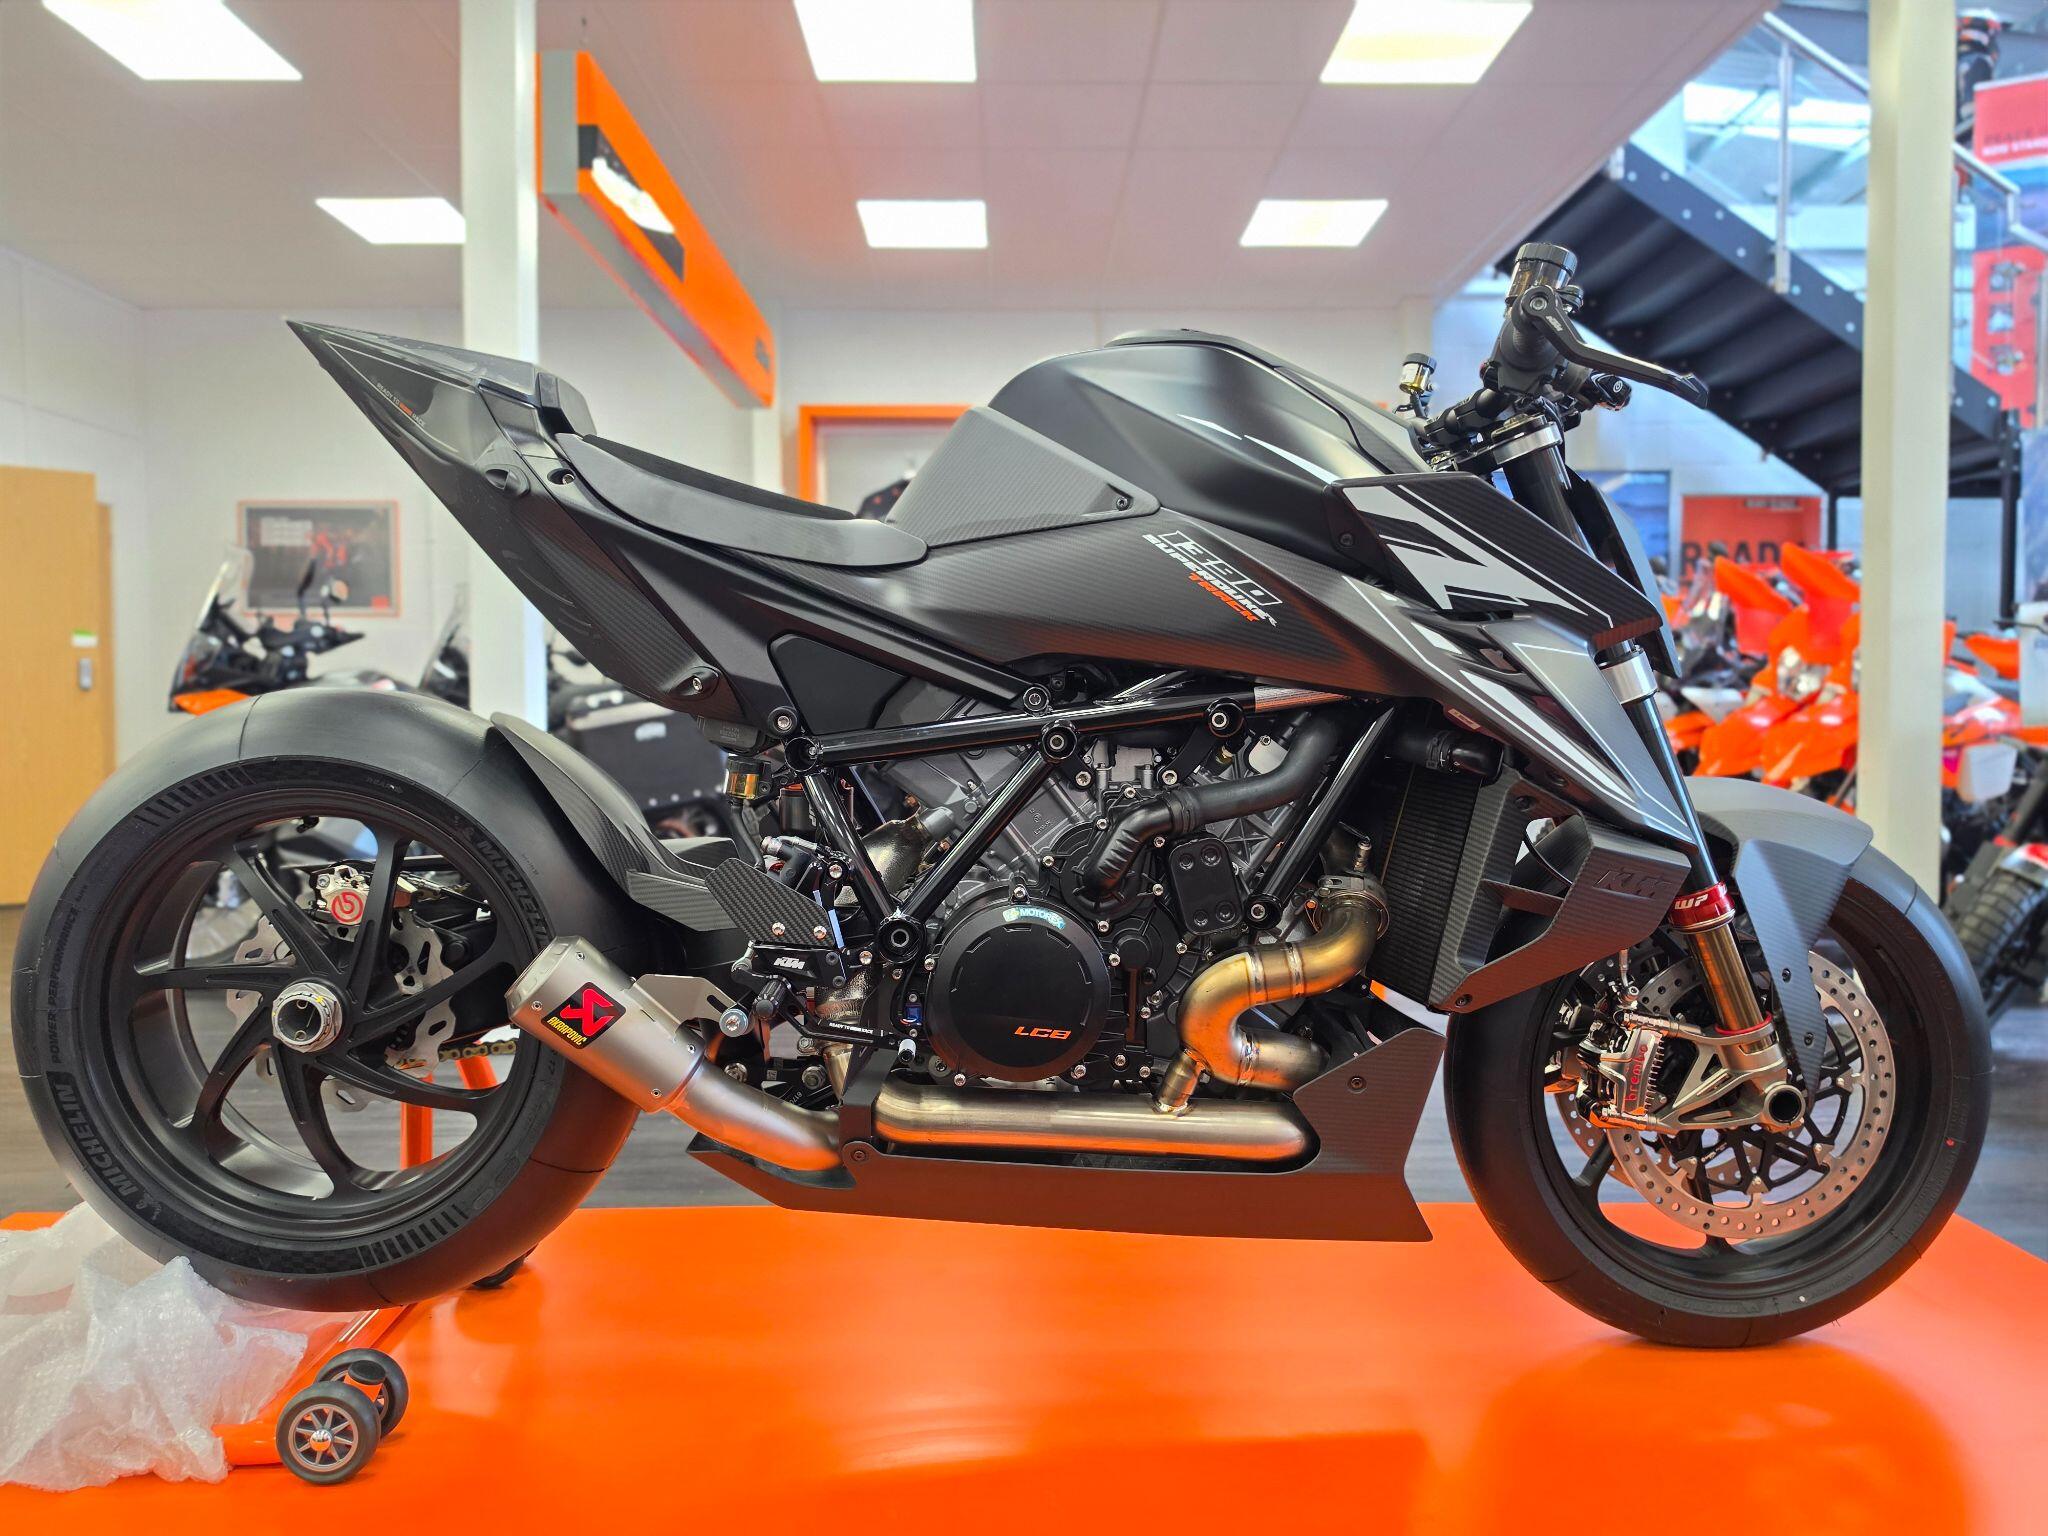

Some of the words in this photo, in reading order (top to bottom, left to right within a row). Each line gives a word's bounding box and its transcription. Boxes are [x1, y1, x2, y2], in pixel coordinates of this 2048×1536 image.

[1681, 540, 1781, 577] RAD
[1188, 571, 1260, 621] TRACK
[1674, 893, 1709, 910] WP
[49, 904, 79, 1004] PERFORMANCE
[773, 956, 806, 970] KTM
[48, 1005, 63, 1065] POWER
[1624, 1044, 1649, 1102] brembo
[55, 1083, 139, 1197] MICHELIN
